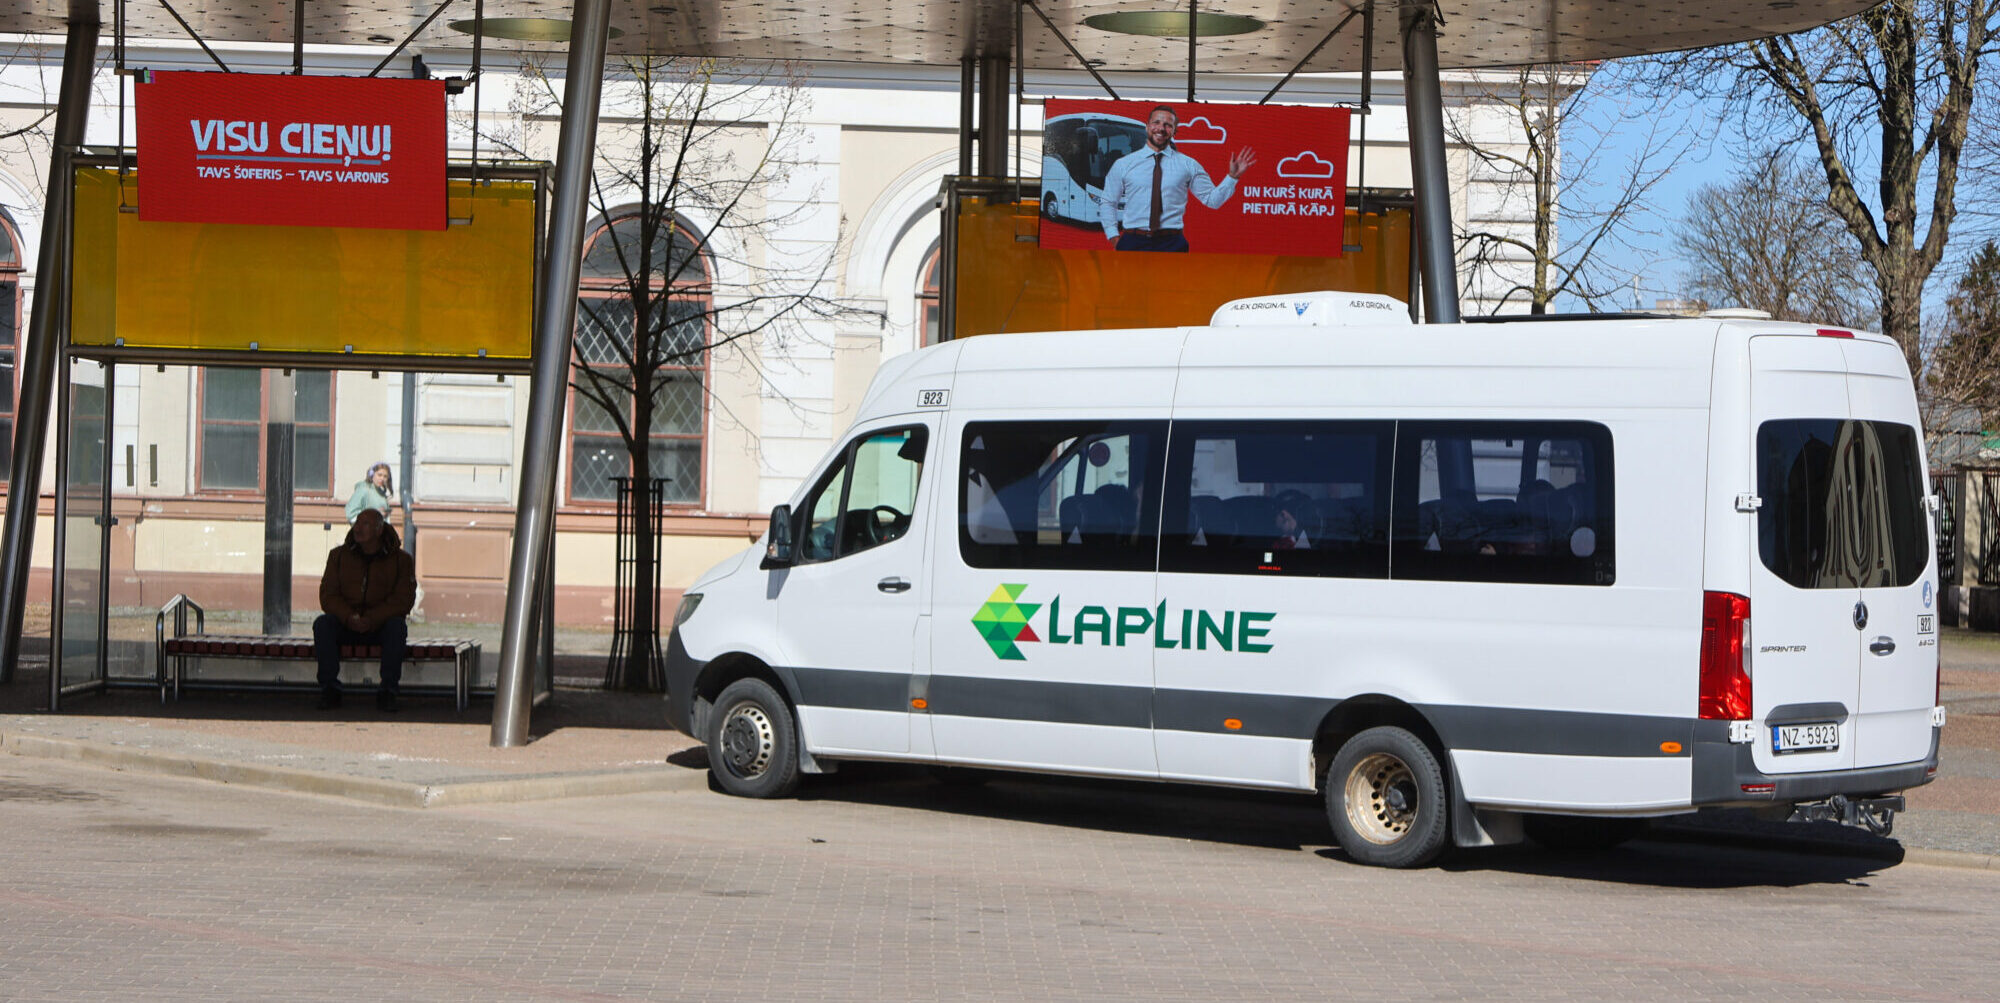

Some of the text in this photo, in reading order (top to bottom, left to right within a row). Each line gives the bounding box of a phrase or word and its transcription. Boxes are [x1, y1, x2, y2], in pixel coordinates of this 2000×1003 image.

[190, 119, 391, 167] VISU CIEŅU!
[196, 166, 231, 179] TAVS
[233, 164, 283, 181] ŠOFERIS
[298, 169, 333, 183] TAVS
[335, 170, 390, 184] VARONIS
[1243, 184, 1334, 200] UN KURŠ KURĀ
[1242, 202, 1335, 217] PIETURĀ KĀPJ
[1231, 303, 1250, 311] ALEX
[1251, 302, 1287, 310] ORIGINAL
[1349, 300, 1365, 308] ALEX
[923, 391, 943, 405] 923
[1048, 593, 1278, 654] LAPLINE
[1920, 617, 1931, 632] 923
[1760, 645, 1807, 653] SPRINTER
